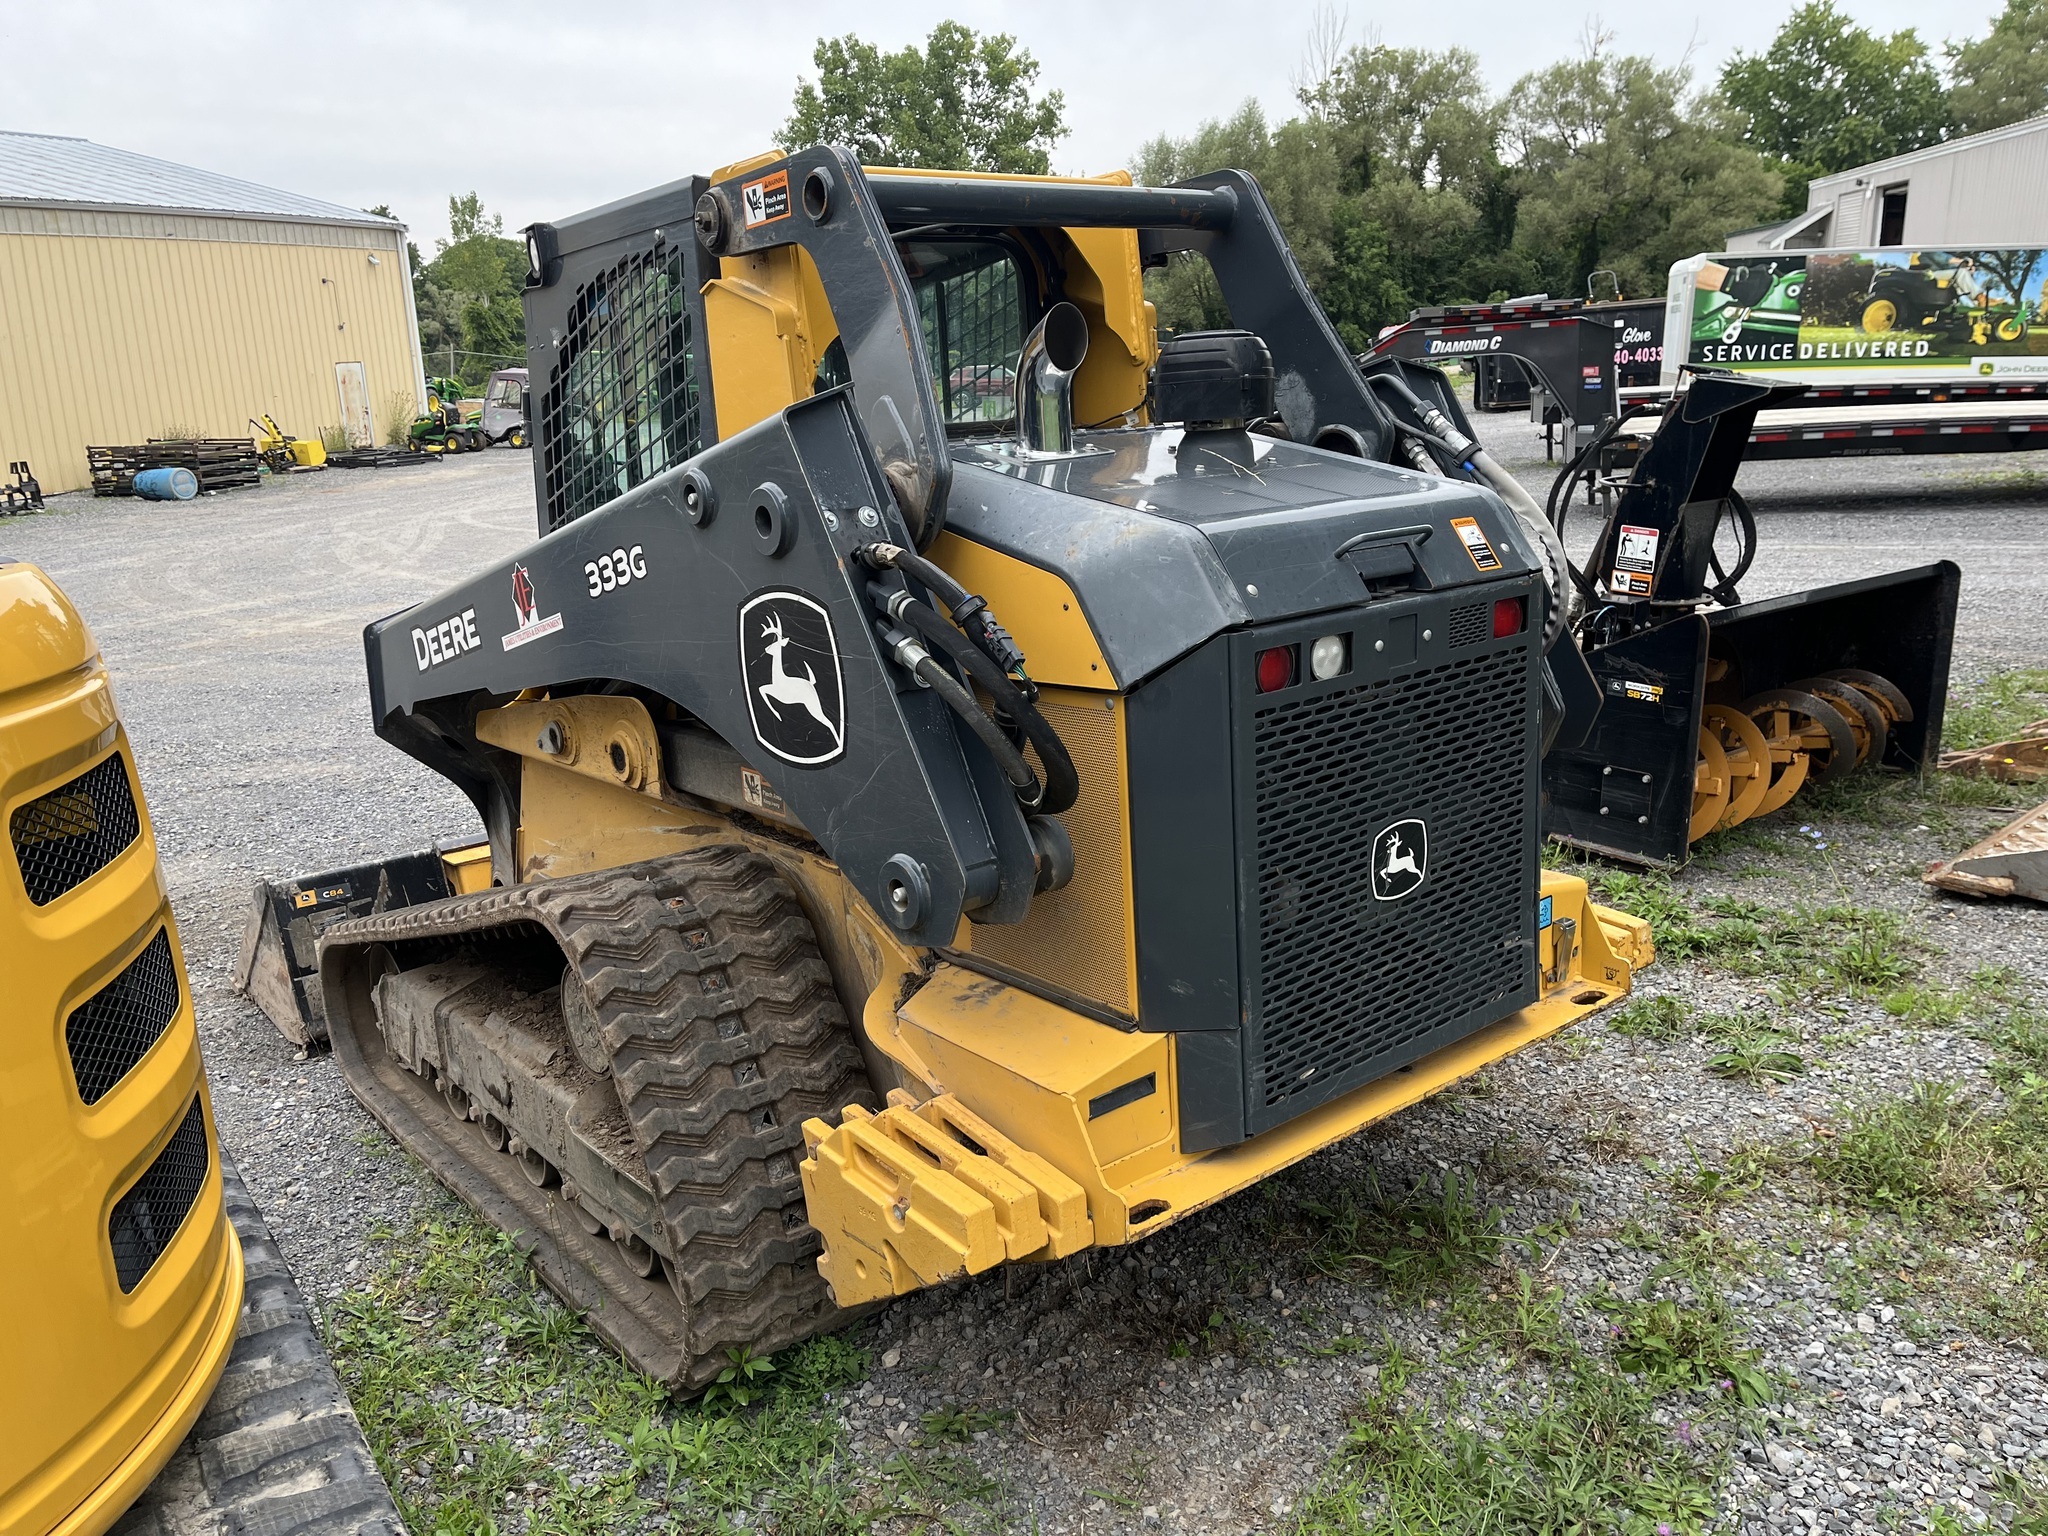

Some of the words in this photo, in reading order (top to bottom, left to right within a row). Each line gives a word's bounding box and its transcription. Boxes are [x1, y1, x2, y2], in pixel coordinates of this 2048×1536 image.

[1622, 327, 1652, 343] Glove
[1429, 338, 1489, 354] DIAMOND
[1489, 335, 1503, 350] C
[1702, 343, 1796, 362] SERVICE
[1800, 340, 1930, 360] DELIVERED
[1996, 363, 2022, 373] JOHN
[584, 545, 647, 598] 333G
[411, 608, 481, 671] DEERE
[1627, 689, 1660, 703] SB72H
[322, 887, 344, 899] C84
